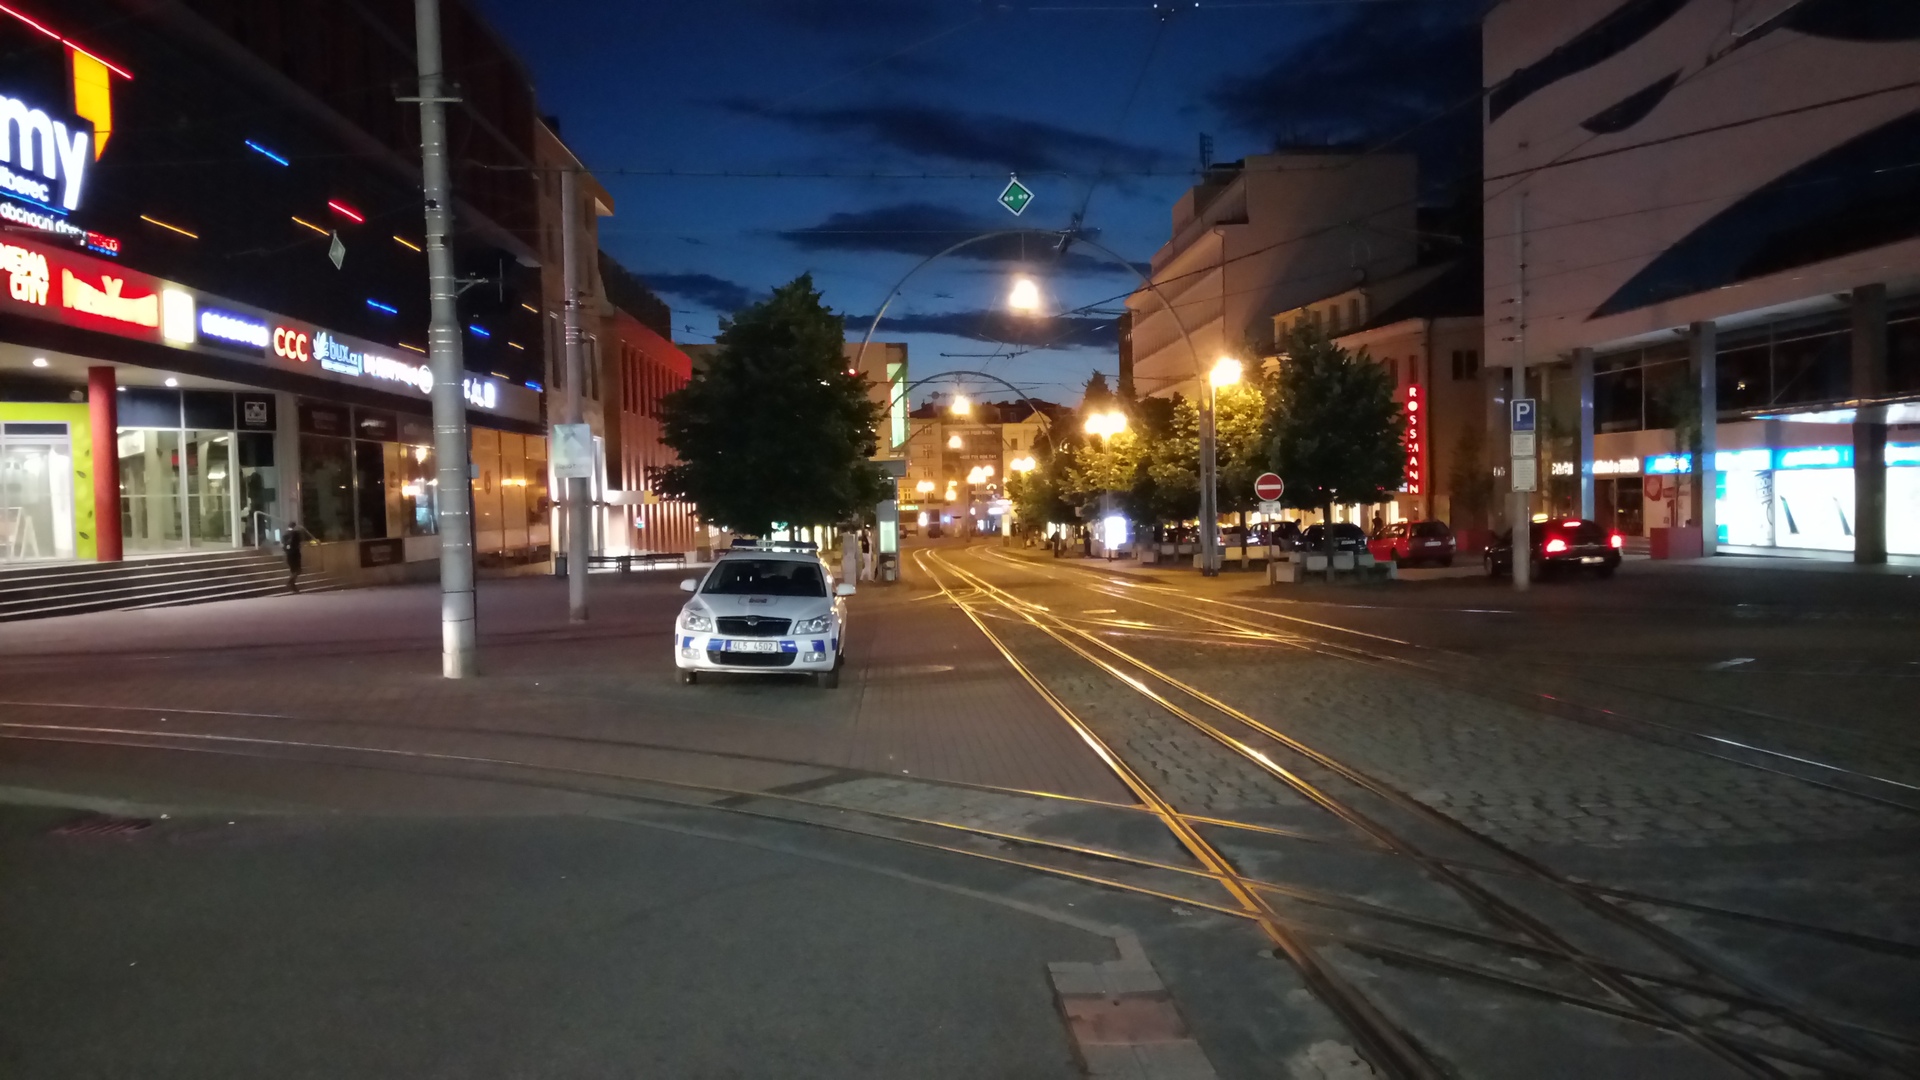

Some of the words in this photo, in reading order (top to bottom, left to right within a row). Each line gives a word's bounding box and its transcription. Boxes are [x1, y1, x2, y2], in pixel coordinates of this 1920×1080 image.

[273, 327, 308, 362] CCC
[1516, 402, 1530, 422] P
[1407, 387, 1419, 494] ROSSMANN
[753, 641, 773, 651] 4502
